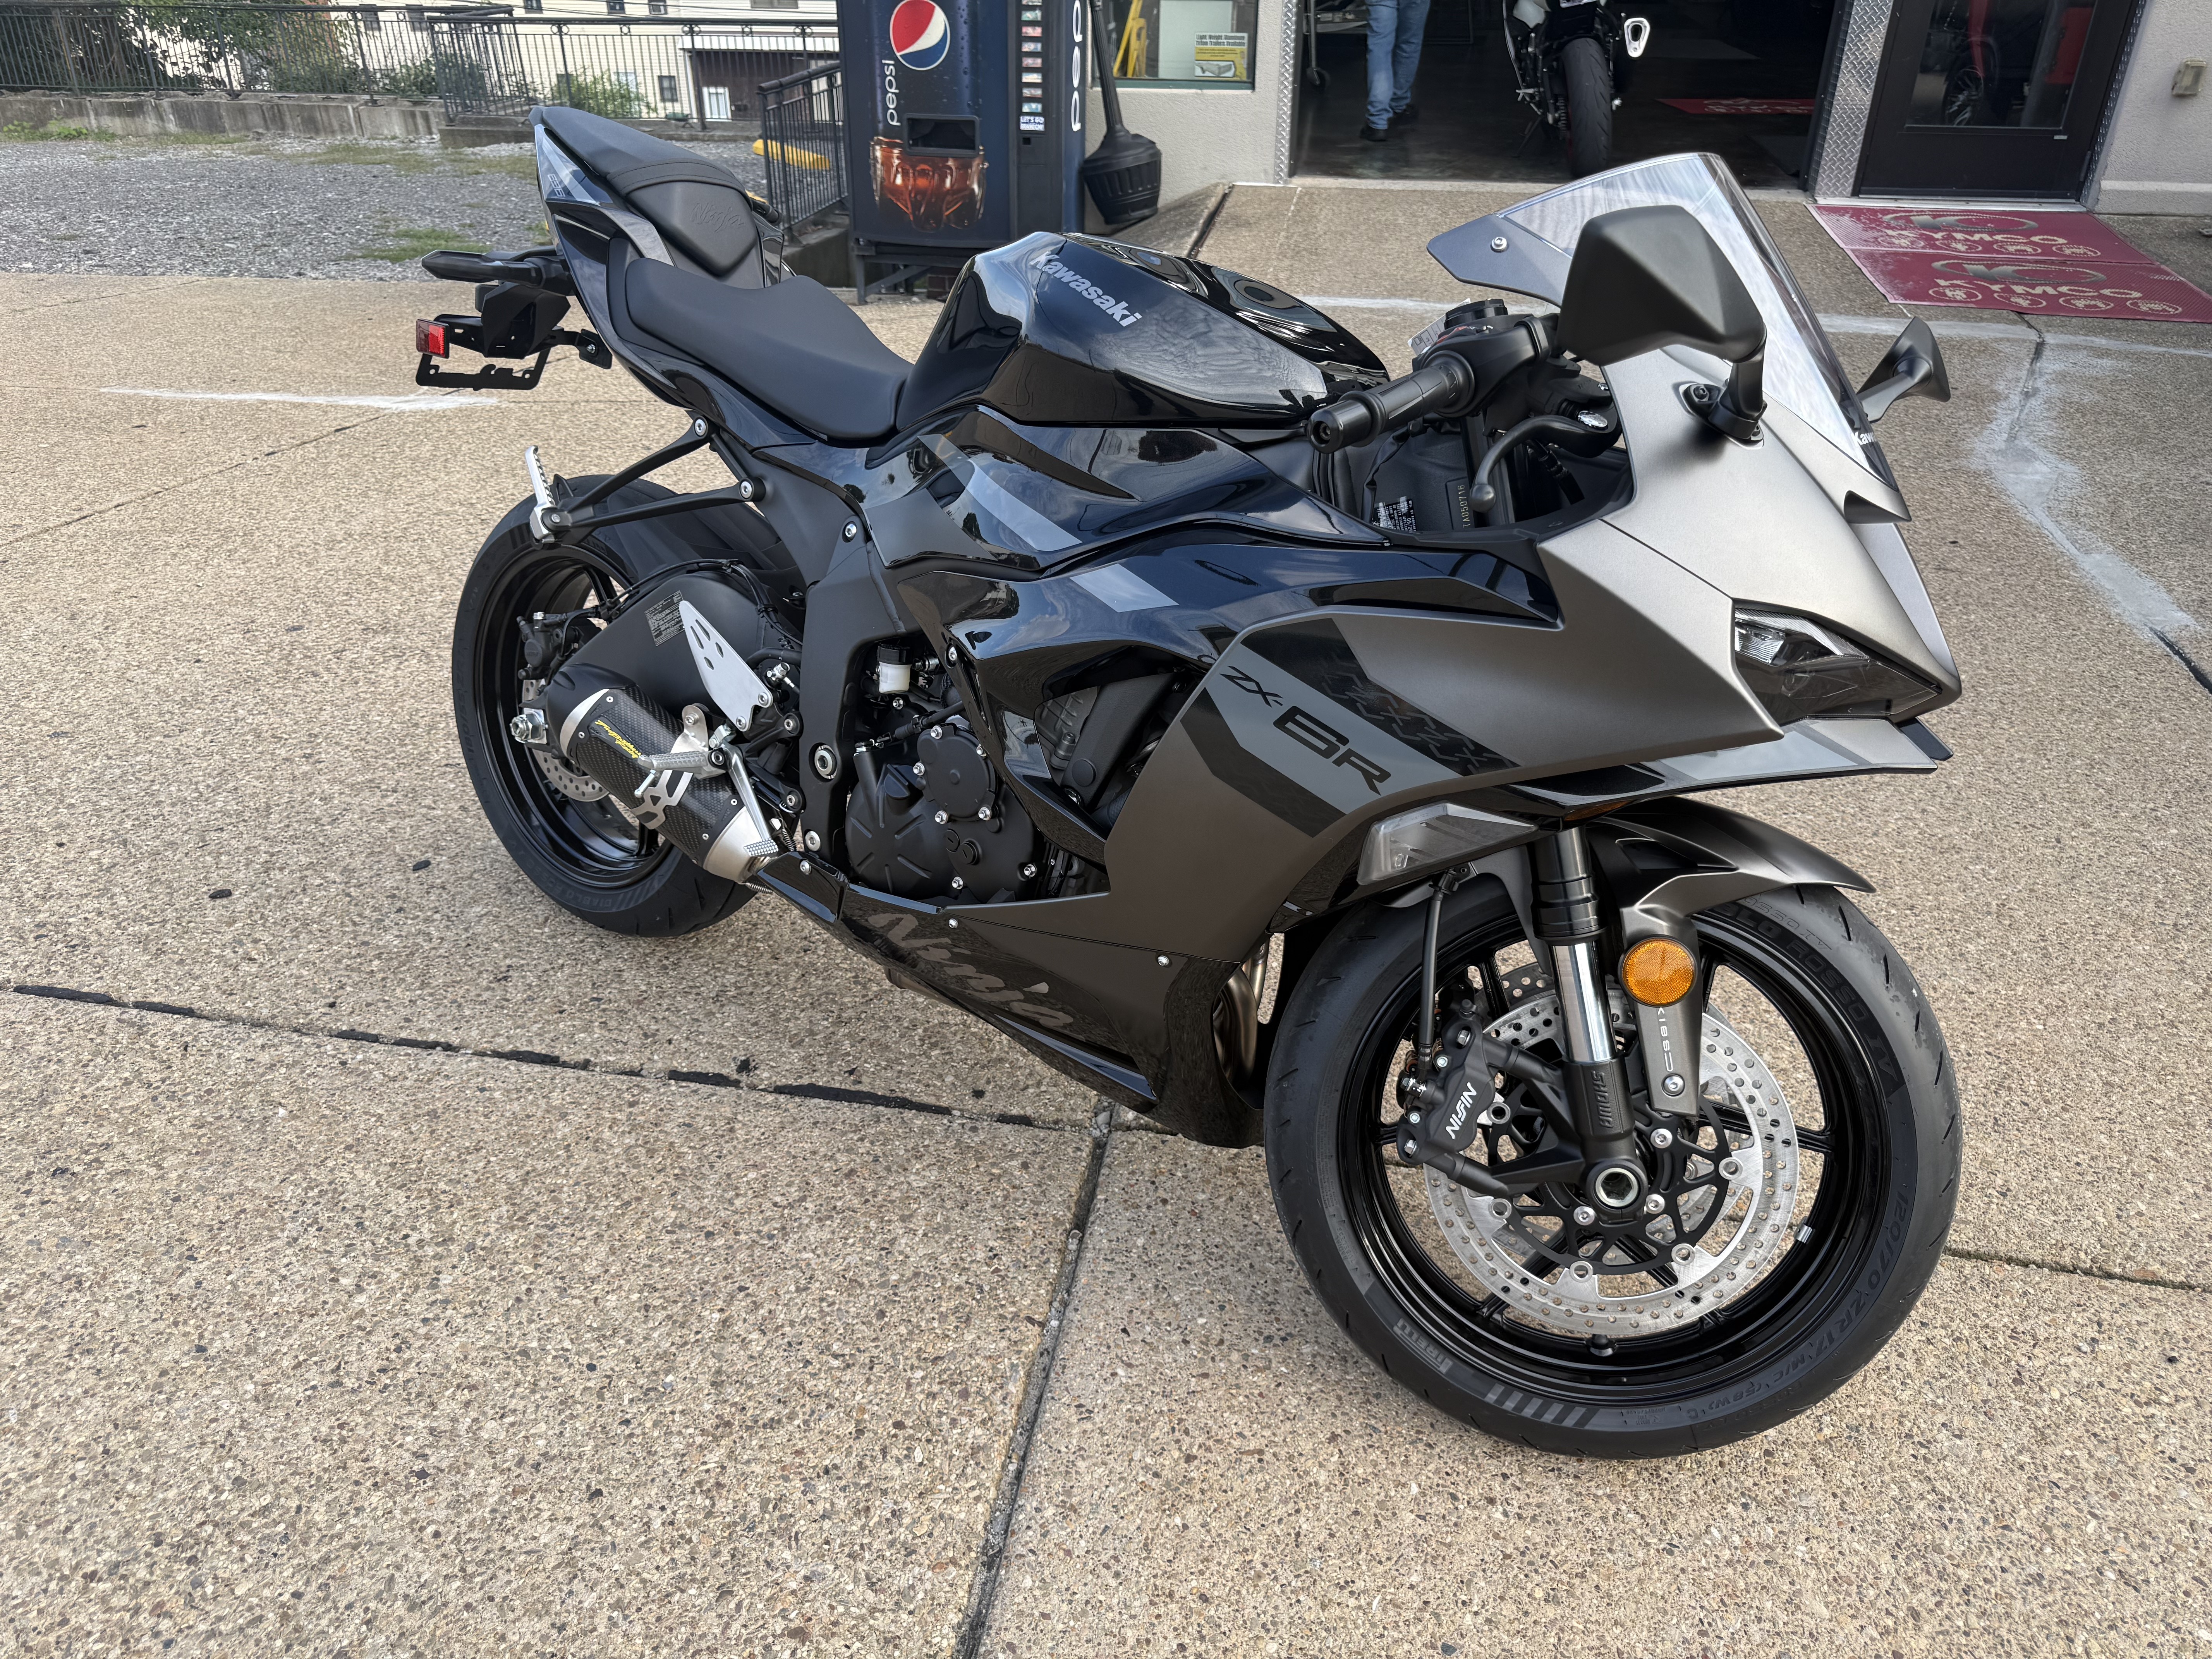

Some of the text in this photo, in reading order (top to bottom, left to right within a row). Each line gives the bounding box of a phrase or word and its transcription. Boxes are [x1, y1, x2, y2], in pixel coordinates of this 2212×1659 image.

[882, 60, 901, 126] pepsi
[547, 173, 566, 197] 636
[690, 203, 746, 232] Ninja
[1884, 229, 2068, 244] KYMCO
[1029, 251, 1142, 327] Kawasaki
[1934, 278, 2143, 298] KYMCO
[1220, 665, 1391, 796] ZX-6R
[1786, 939, 1870, 1022] ROSSO
[1446, 1082, 1477, 1139] NISSIN
[1591, 1070, 1614, 1128] SHOWA
[1867, 1190, 1908, 1290] 120/70
[1393, 1317, 1453, 1374] PIRELLI
